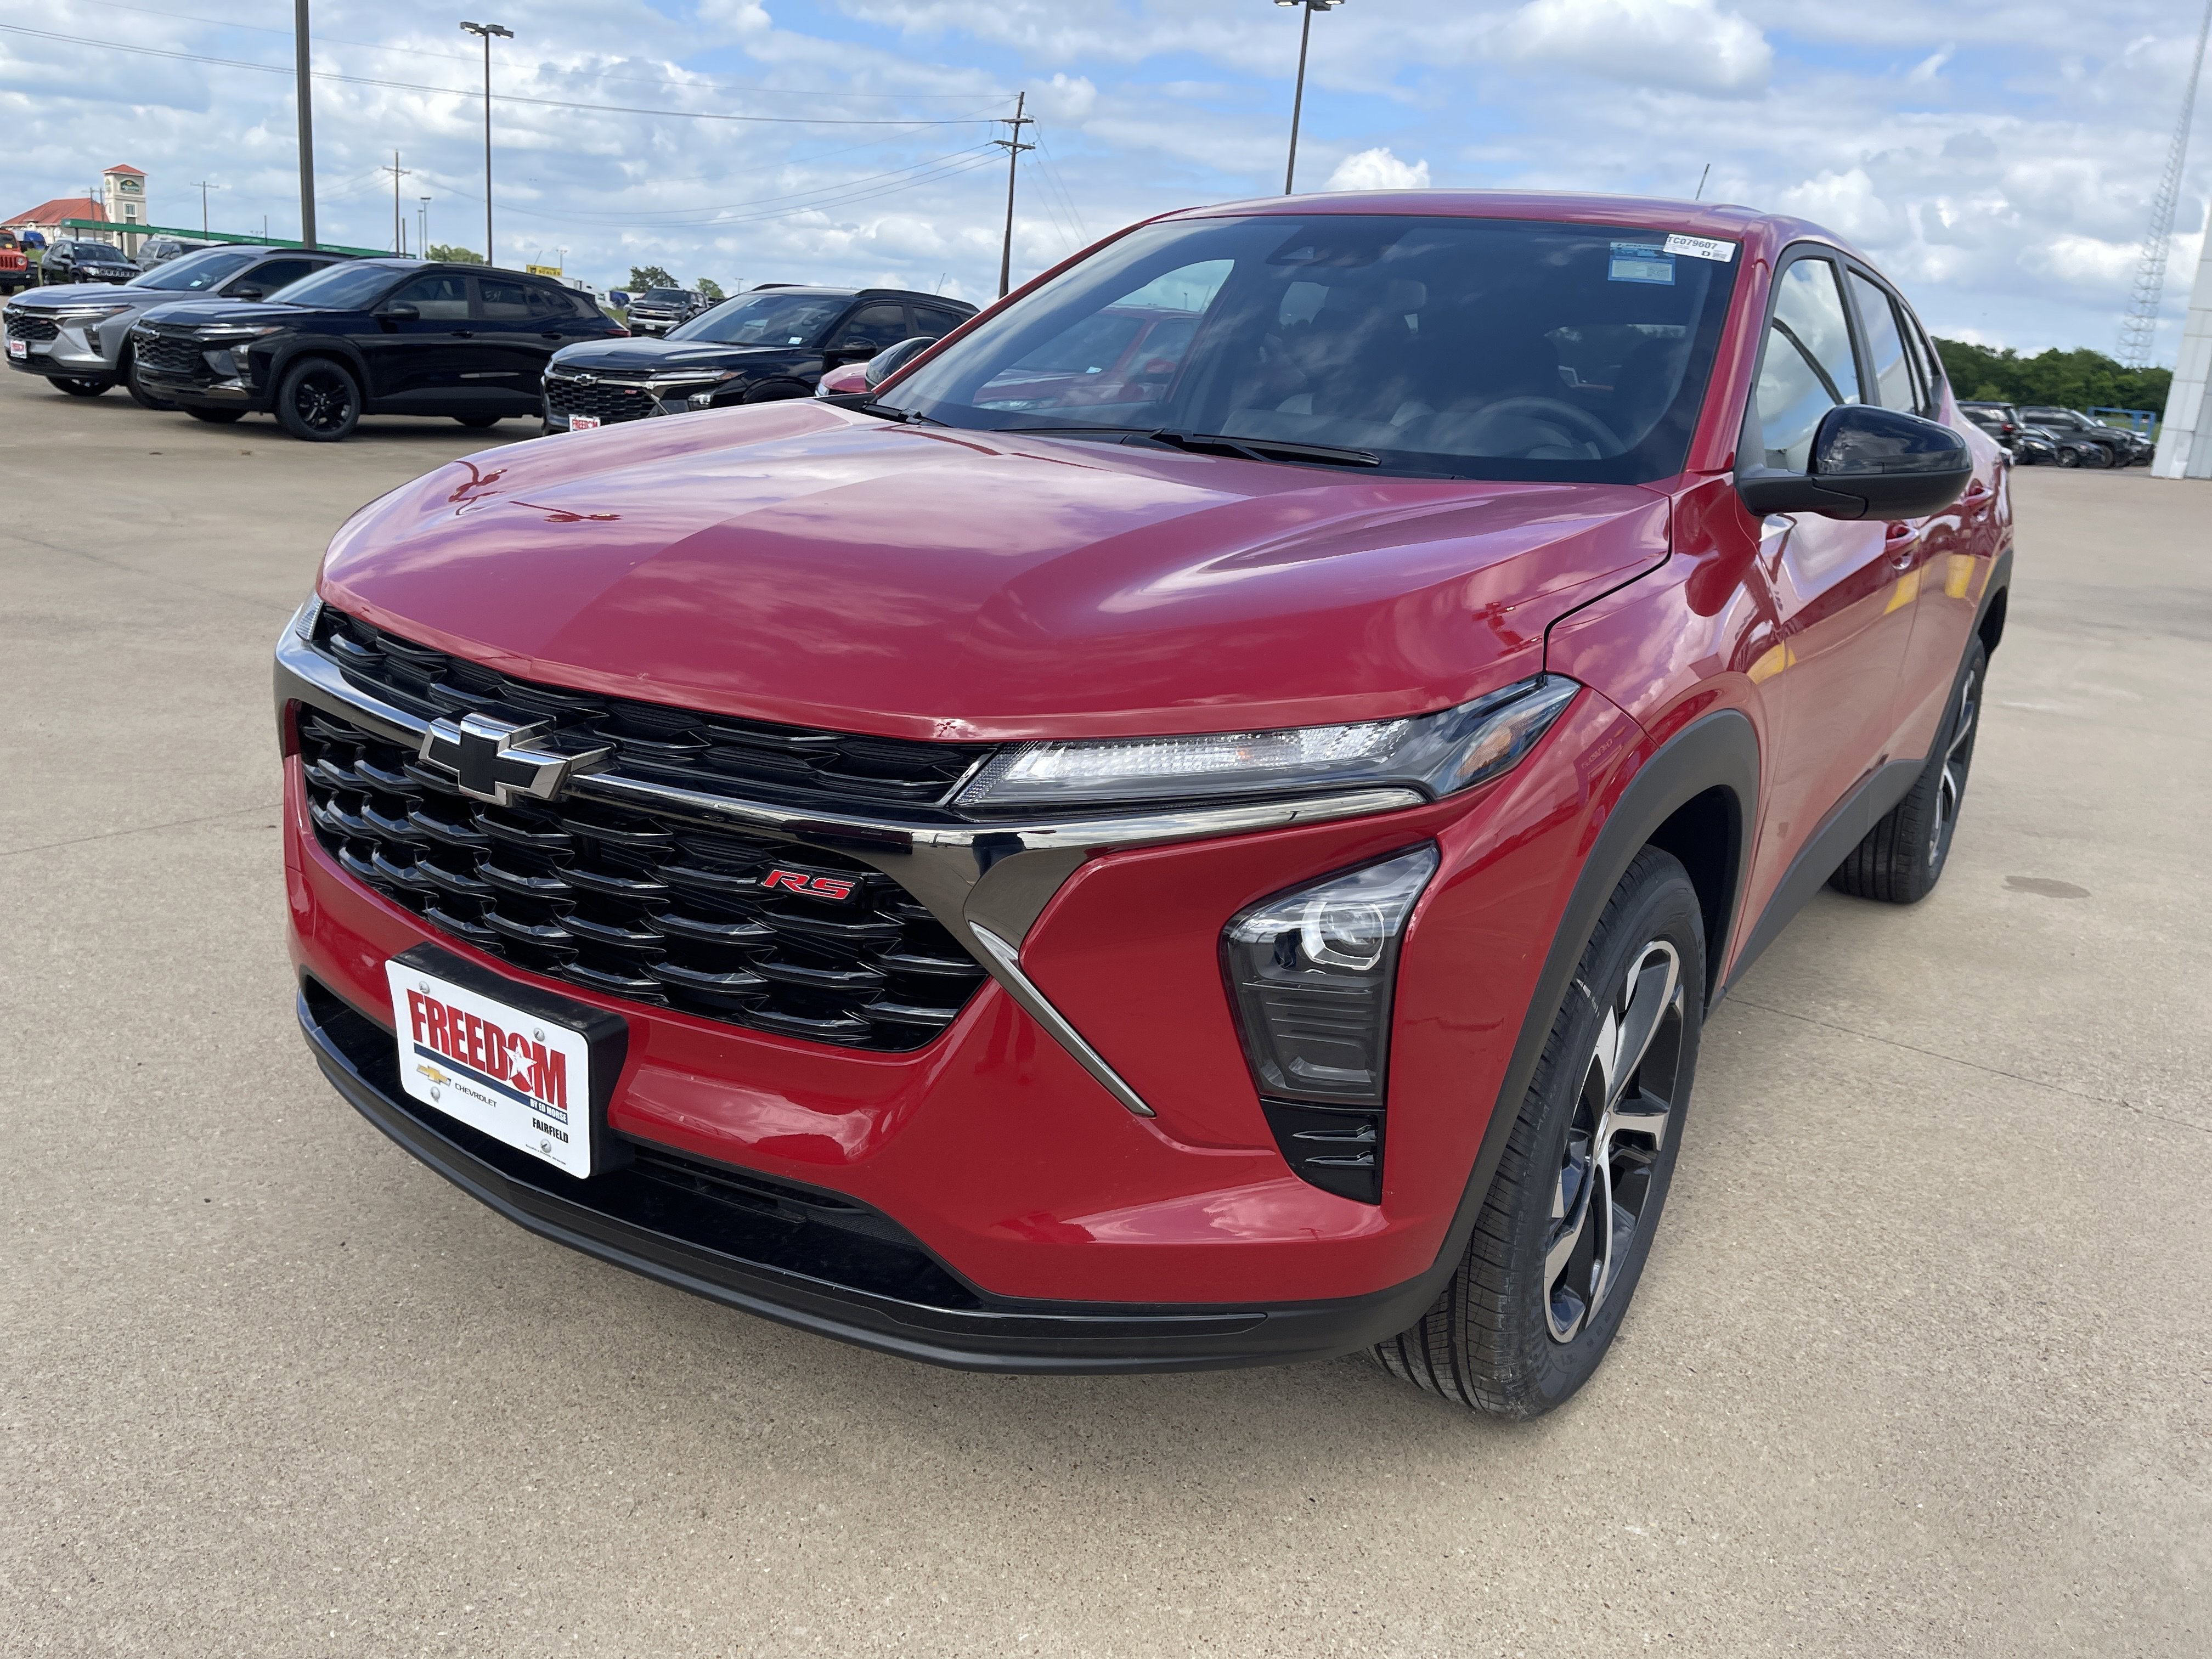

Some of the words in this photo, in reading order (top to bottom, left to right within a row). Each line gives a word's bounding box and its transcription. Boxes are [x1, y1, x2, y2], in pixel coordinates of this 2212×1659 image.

[1668, 236, 1717, 249] TC079607
[763, 870, 855, 899] RS
[407, 989, 567, 1110] FREEDOM
[455, 1083, 497, 1108] CHEVROLET
[530, 1098, 538, 1109] BY
[538, 1102, 546, 1113] ED
[546, 1106, 567, 1123] MORSE
[533, 1117, 568, 1143] FAIRFIELD
